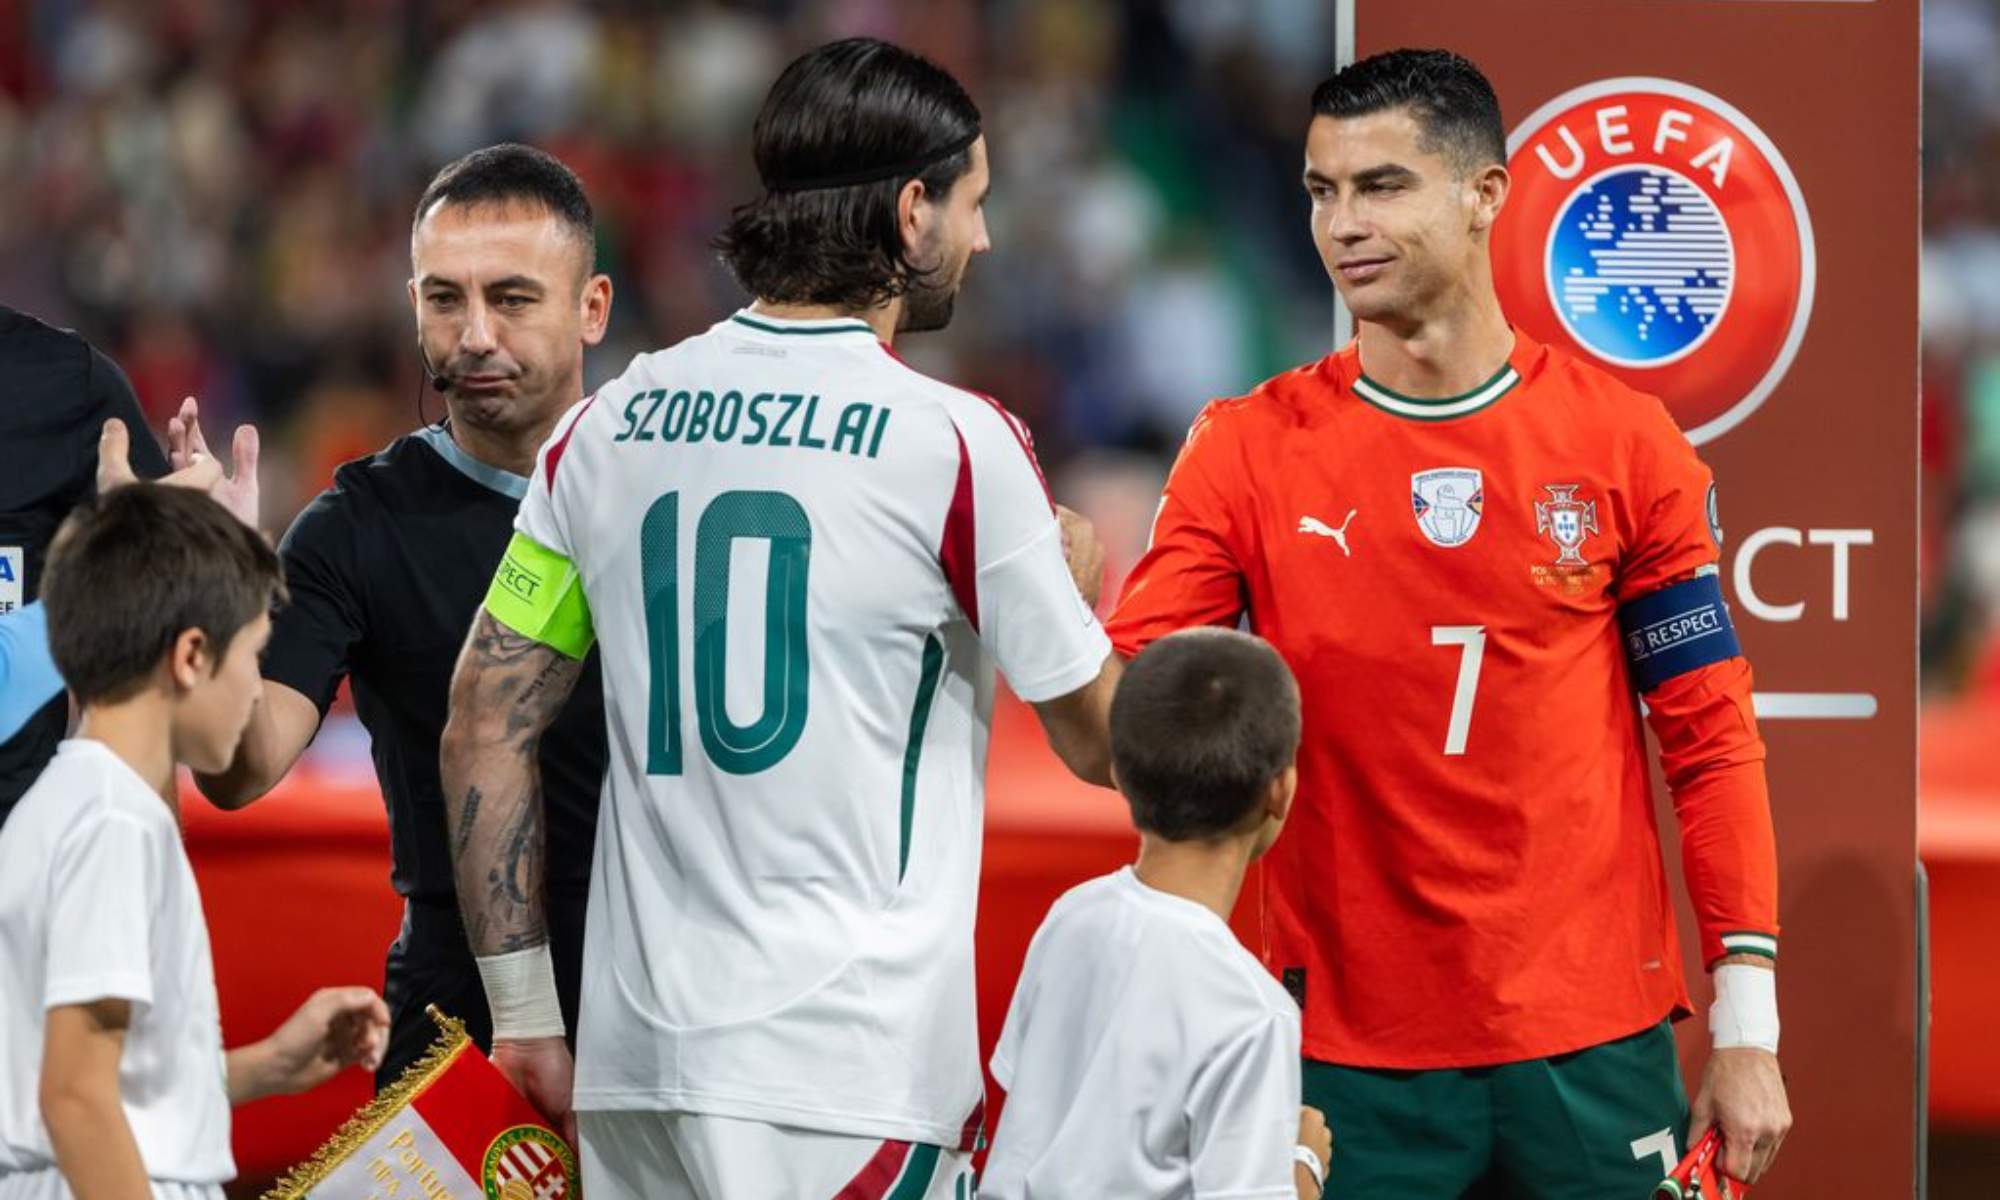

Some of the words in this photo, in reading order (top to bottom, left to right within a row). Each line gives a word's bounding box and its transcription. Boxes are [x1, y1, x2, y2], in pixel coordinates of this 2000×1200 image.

[1534, 104, 1735, 189] UEFA
[613, 387, 892, 459] SZOBOSZLAI
[502, 561, 541, 598] PECT
[1732, 525, 1875, 622] CT
[640, 489, 812, 776] 10
[1646, 609, 1719, 649] RESPECT
[1430, 624, 1487, 756] 7
